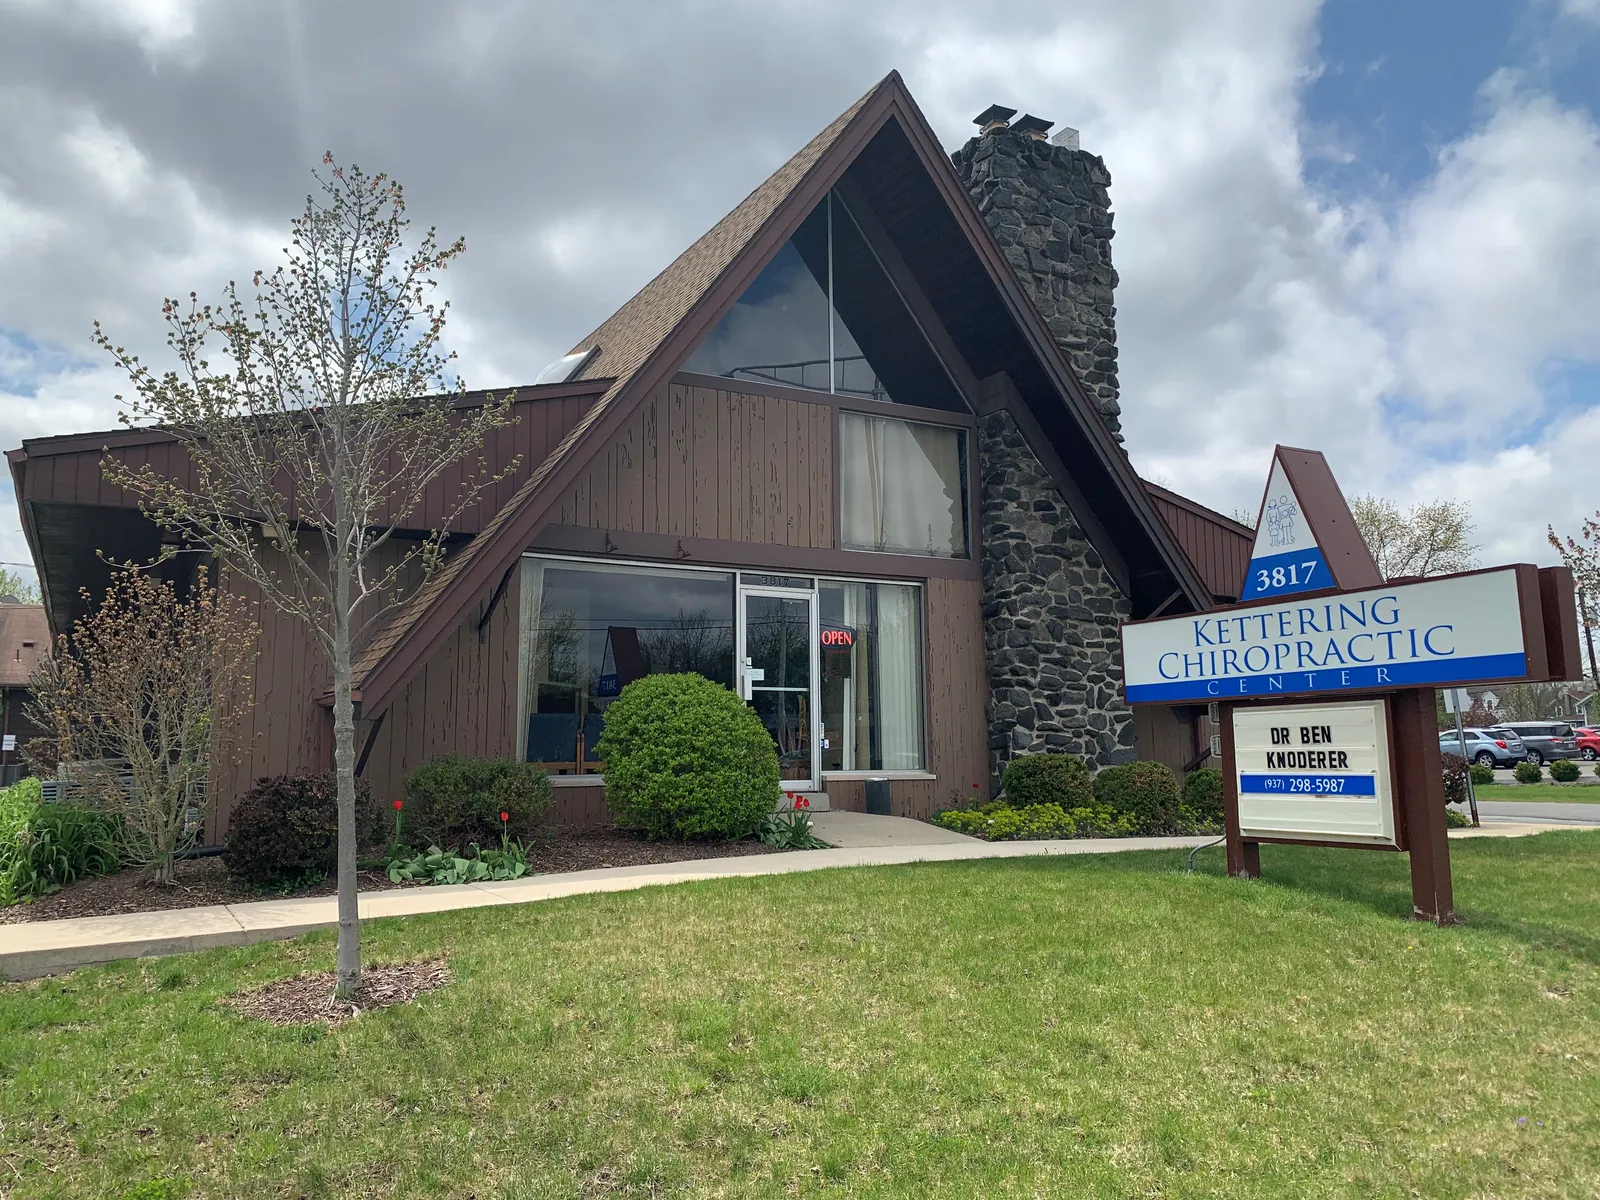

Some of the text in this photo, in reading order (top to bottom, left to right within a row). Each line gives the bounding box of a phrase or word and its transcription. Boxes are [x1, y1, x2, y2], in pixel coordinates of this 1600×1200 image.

[761, 576, 790, 587] 3817
[1256, 560, 1318, 592] 3817
[1193, 596, 1400, 647] KETTERING
[821, 630, 852, 645] OPEN
[1158, 624, 1456, 680] CHIROPRACTIC
[1207, 667, 1392, 695] CENTER
[1270, 725, 1332, 745] DR BEN
[1266, 750, 1349, 769] KNODERER
[1264, 778, 1345, 793] (937) 298-5987
